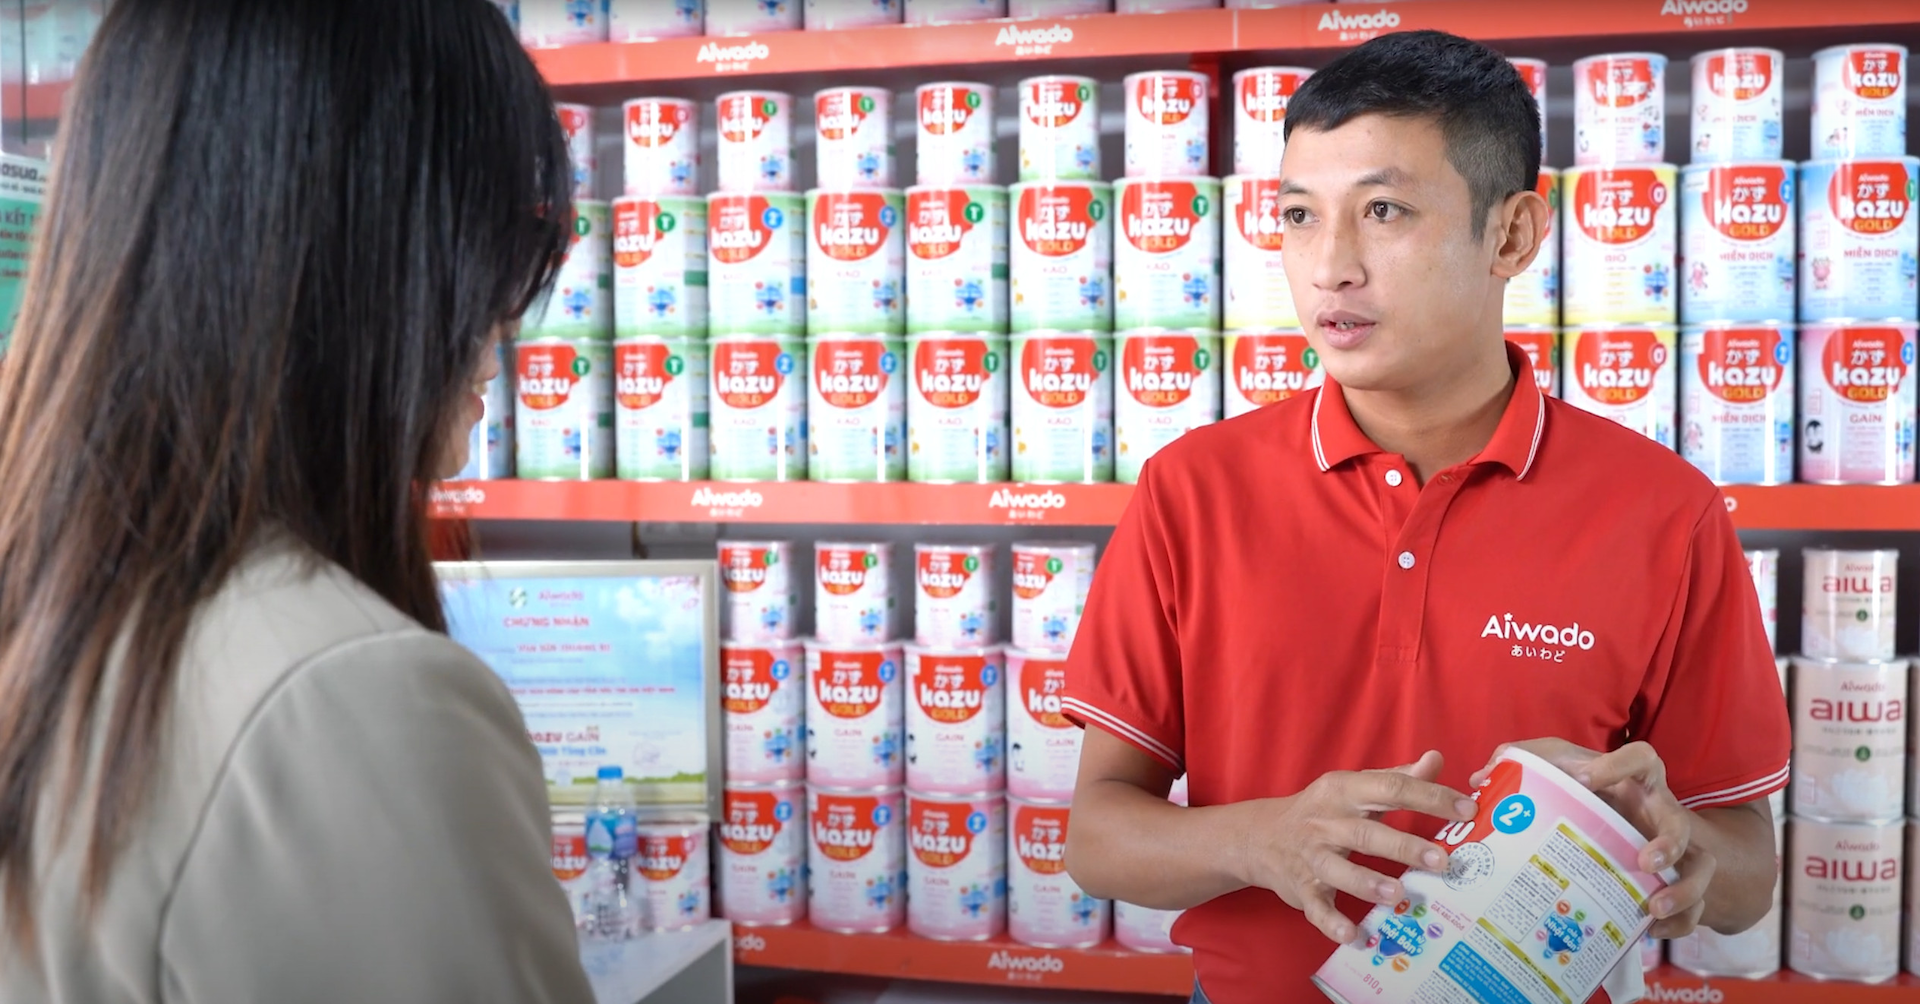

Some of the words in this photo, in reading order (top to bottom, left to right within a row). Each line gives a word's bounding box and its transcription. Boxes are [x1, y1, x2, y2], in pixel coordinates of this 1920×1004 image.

[1317, 9, 1400, 31] Aiwado
[996, 25, 1074, 46] Aiwado
[697, 41, 769, 63] Aiwado
[1851, 71, 1899, 88] kazu
[1584, 203, 1651, 227] kazu
[1715, 198, 1780, 223] kazu
[1841, 195, 1906, 218] kazu
[1027, 218, 1087, 241] kazu
[1129, 214, 1189, 236] kazu
[821, 370, 879, 392] kazu
[922, 370, 980, 392] kazu
[1030, 368, 1090, 391] kazu
[1131, 367, 1191, 390] kazu
[1241, 367, 1302, 390] kazu
[1585, 363, 1651, 388] kazu
[1709, 362, 1776, 386] kazu
[1833, 362, 1901, 386] kazu
[691, 488, 763, 507] Aiwado
[989, 488, 1066, 508] Aiwado
[1481, 612, 1595, 650] Aiwado
[1511, 645, 1565, 663] あいわど
[821, 679, 878, 703] kazu
[922, 684, 980, 707] kazu
[1810, 699, 1901, 723] aiwa
[1499, 802, 1531, 826] 2+
[1020, 834, 1066, 860] kaz
[1805, 856, 1897, 881] aiwa
[987, 951, 1064, 972] Aiwado
[1363, 974, 1381, 991] 810
[1376, 988, 1384, 997] g
